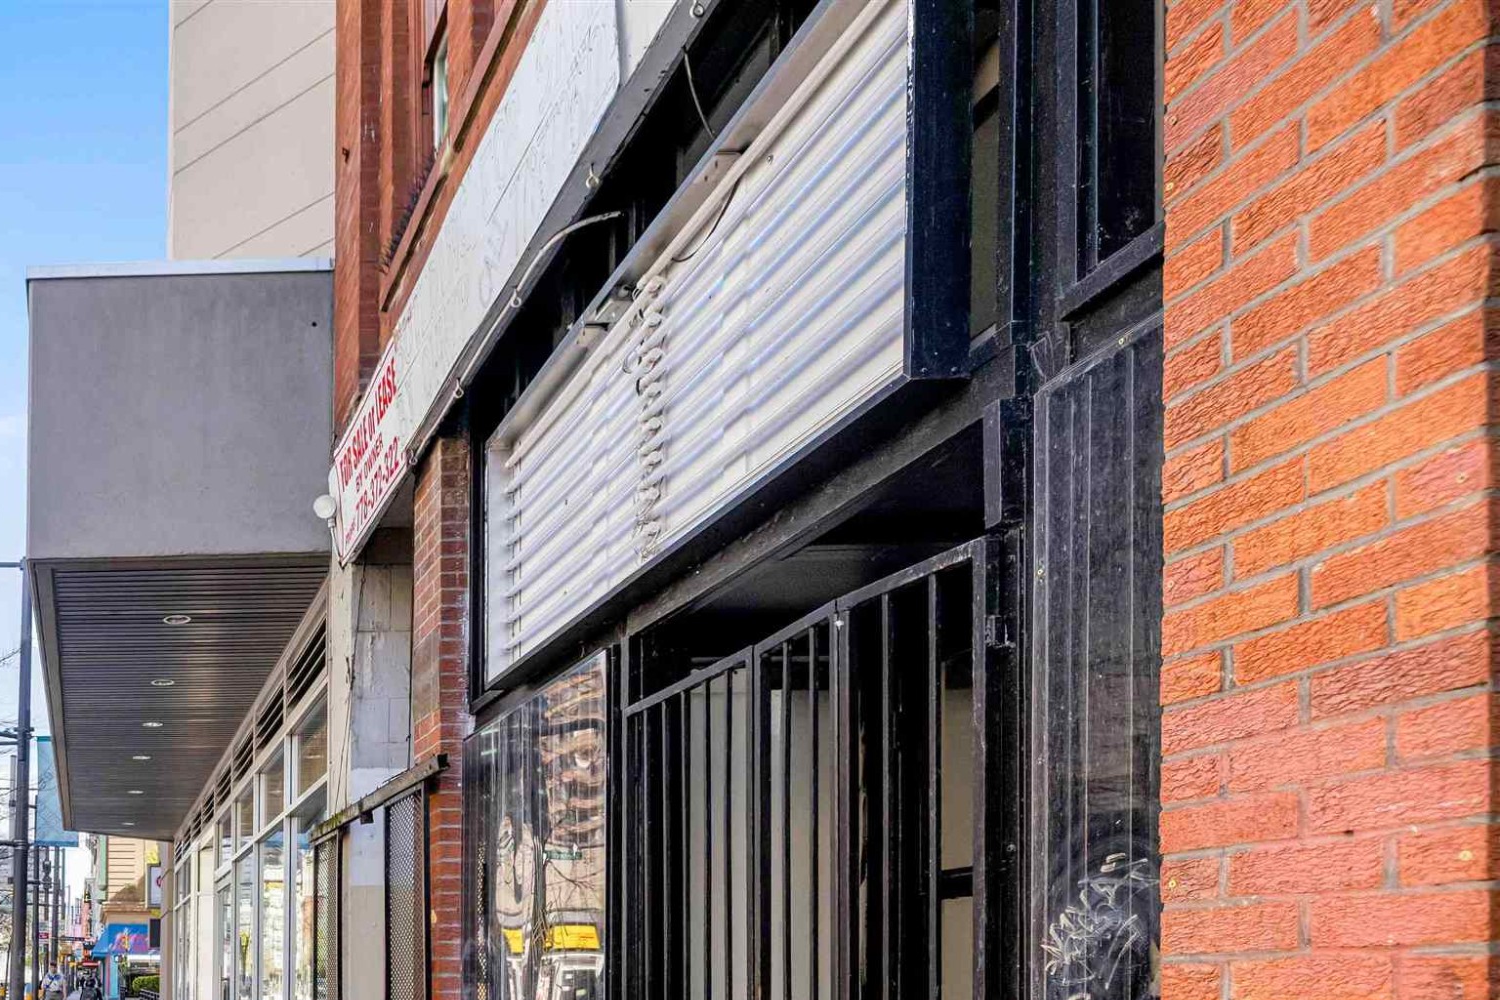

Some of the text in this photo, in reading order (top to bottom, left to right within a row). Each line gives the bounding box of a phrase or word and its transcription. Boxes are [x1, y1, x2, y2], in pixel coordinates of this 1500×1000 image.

[352, 416, 368, 471] SALE
[375, 356, 397, 426] LEASE
[364, 432, 384, 481] OWNER
